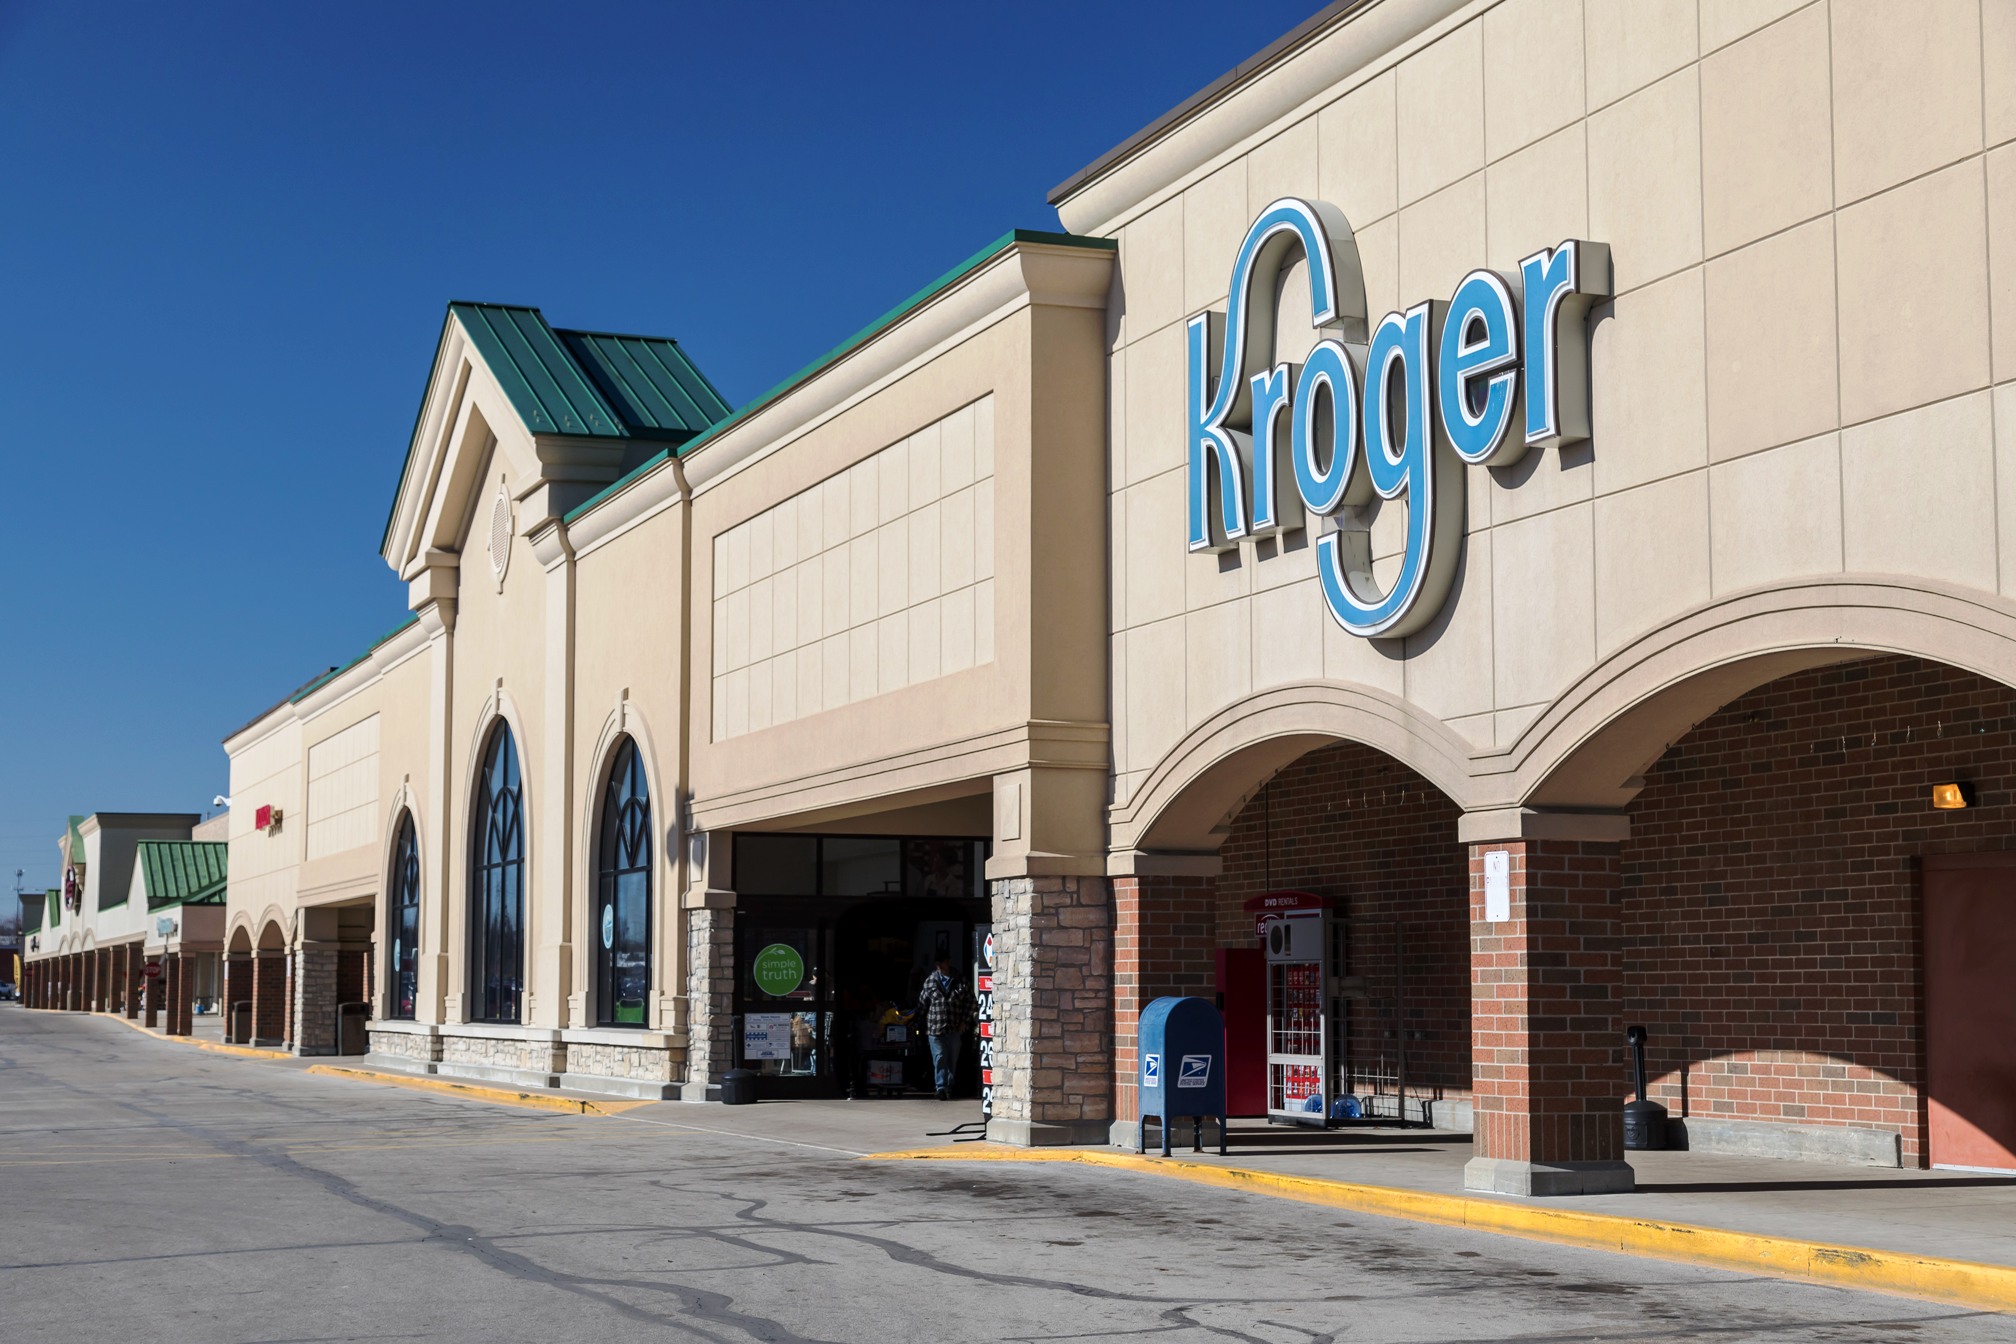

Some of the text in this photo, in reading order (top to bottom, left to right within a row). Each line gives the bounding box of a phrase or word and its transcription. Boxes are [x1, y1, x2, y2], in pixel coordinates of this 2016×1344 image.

[1187, 196, 1582, 638] Kroger
[1264, 897, 1298, 907] DVD RENTALS
[763, 960, 796, 969] simple
[763, 969, 797, 980] truth
